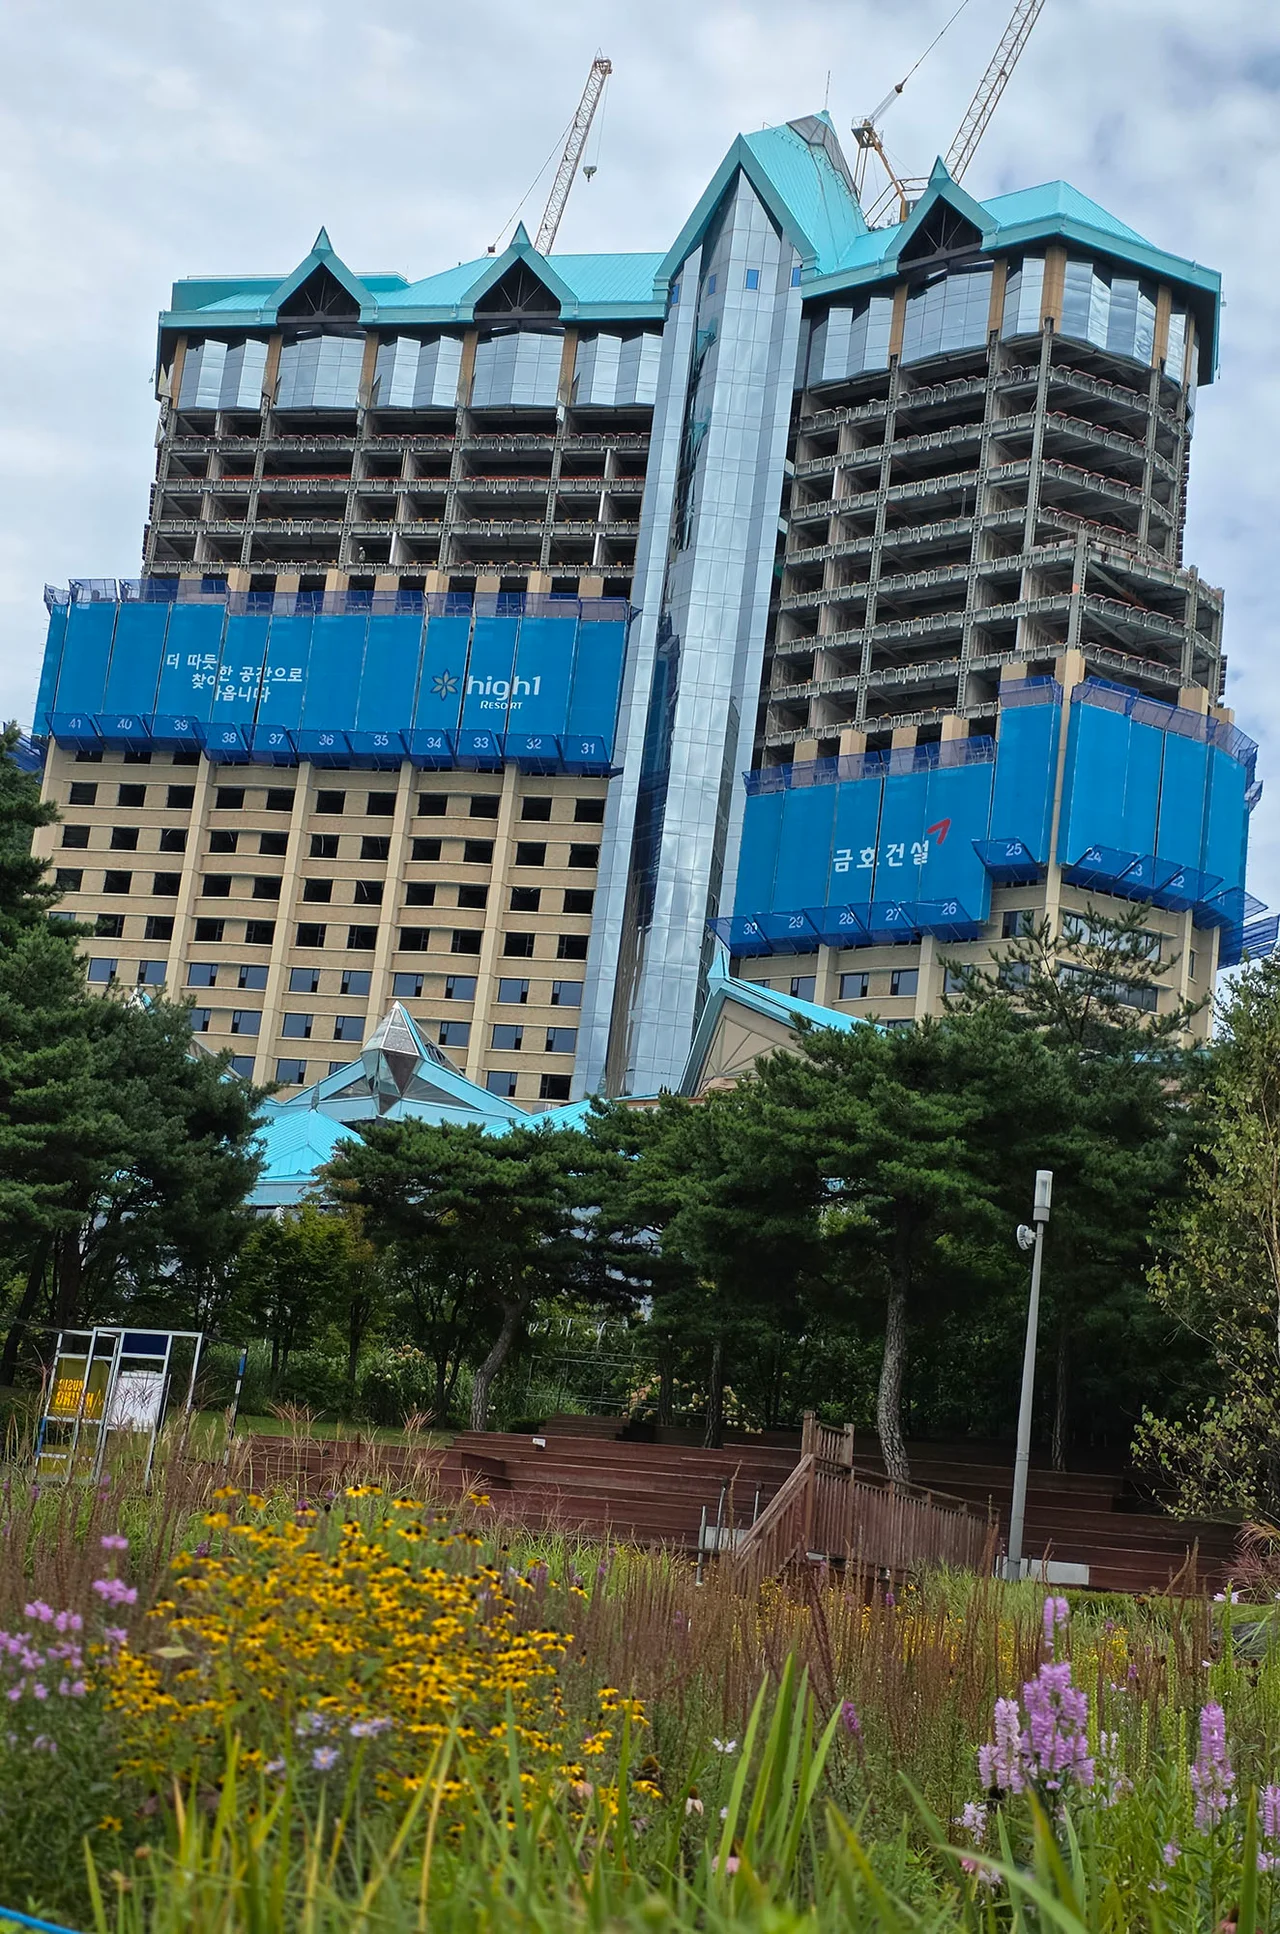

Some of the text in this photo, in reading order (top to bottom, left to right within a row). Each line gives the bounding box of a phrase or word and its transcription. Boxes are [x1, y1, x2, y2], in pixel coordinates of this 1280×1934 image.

[166, 652, 180, 670] 더
[239, 666, 303, 683] 공간으로
[466, 675, 542, 701] high1
[480, 699, 524, 710] RESORT
[68, 717, 83, 730] 41
[116, 717, 133, 731] 40
[173, 718, 189, 731] 39
[221, 731, 237, 744] 38
[268, 732, 285, 745] 37
[318, 733, 335, 746] 36
[373, 734, 390, 747] 35
[426, 736, 443, 749] 34
[473, 736, 490, 749] 33
[525, 737, 543, 750] 32
[580, 742, 596, 755] 31
[832, 839, 930, 873] 금호건설
[1005, 842, 1023, 857] 25
[1086, 848, 1104, 863] 24
[885, 907, 901, 922] 27
[941, 901, 957, 916] 26
